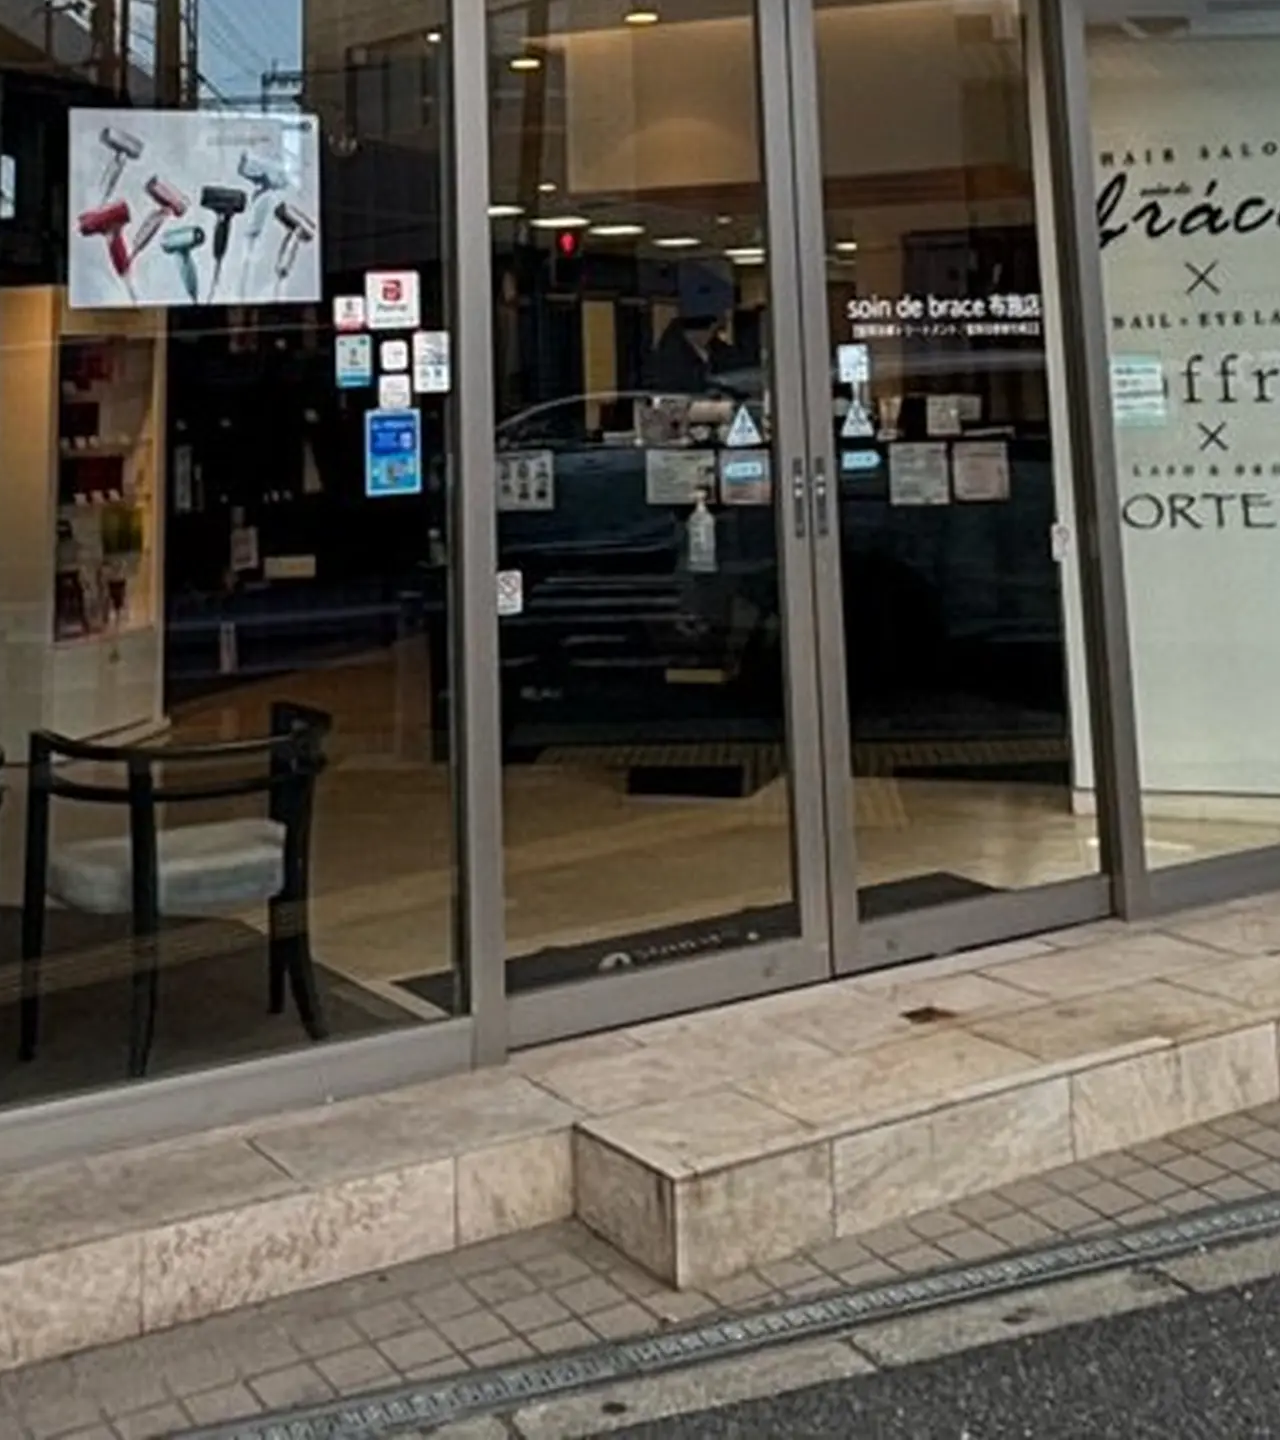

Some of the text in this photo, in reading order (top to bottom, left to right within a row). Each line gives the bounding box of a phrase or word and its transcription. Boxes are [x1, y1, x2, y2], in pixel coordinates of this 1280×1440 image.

[847, 294, 892, 319] soin
[896, 292, 924, 318] de
[927, 293, 986, 318] brace
